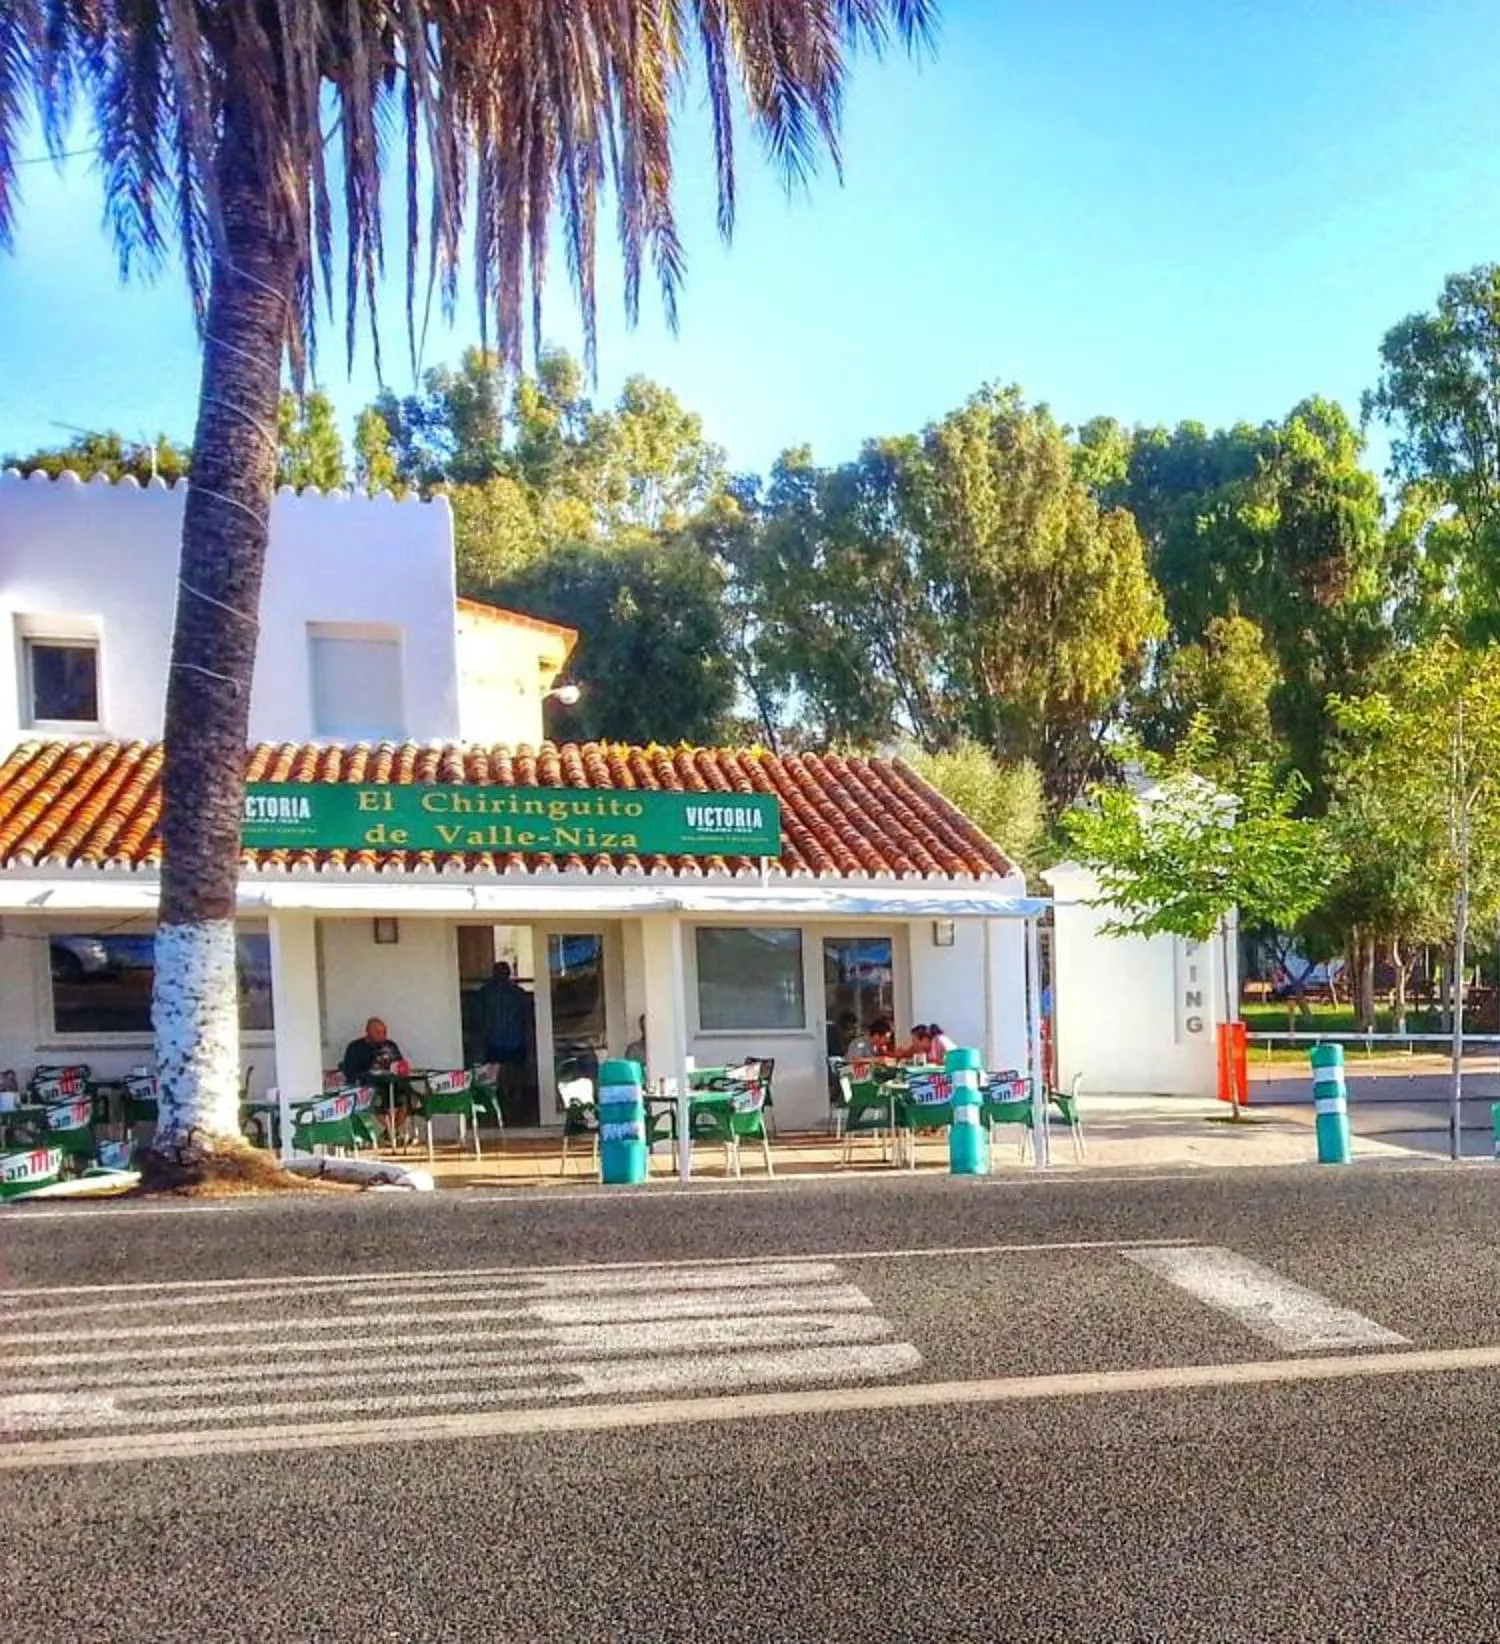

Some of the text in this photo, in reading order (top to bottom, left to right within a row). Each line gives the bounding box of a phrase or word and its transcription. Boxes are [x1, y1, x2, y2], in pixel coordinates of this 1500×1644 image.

[244, 796, 311, 819] CTORIA
[358, 791, 643, 820] El Chiringuito
[686, 806, 762, 829] VICTORIA
[364, 824, 638, 848] de Valle-Niza
